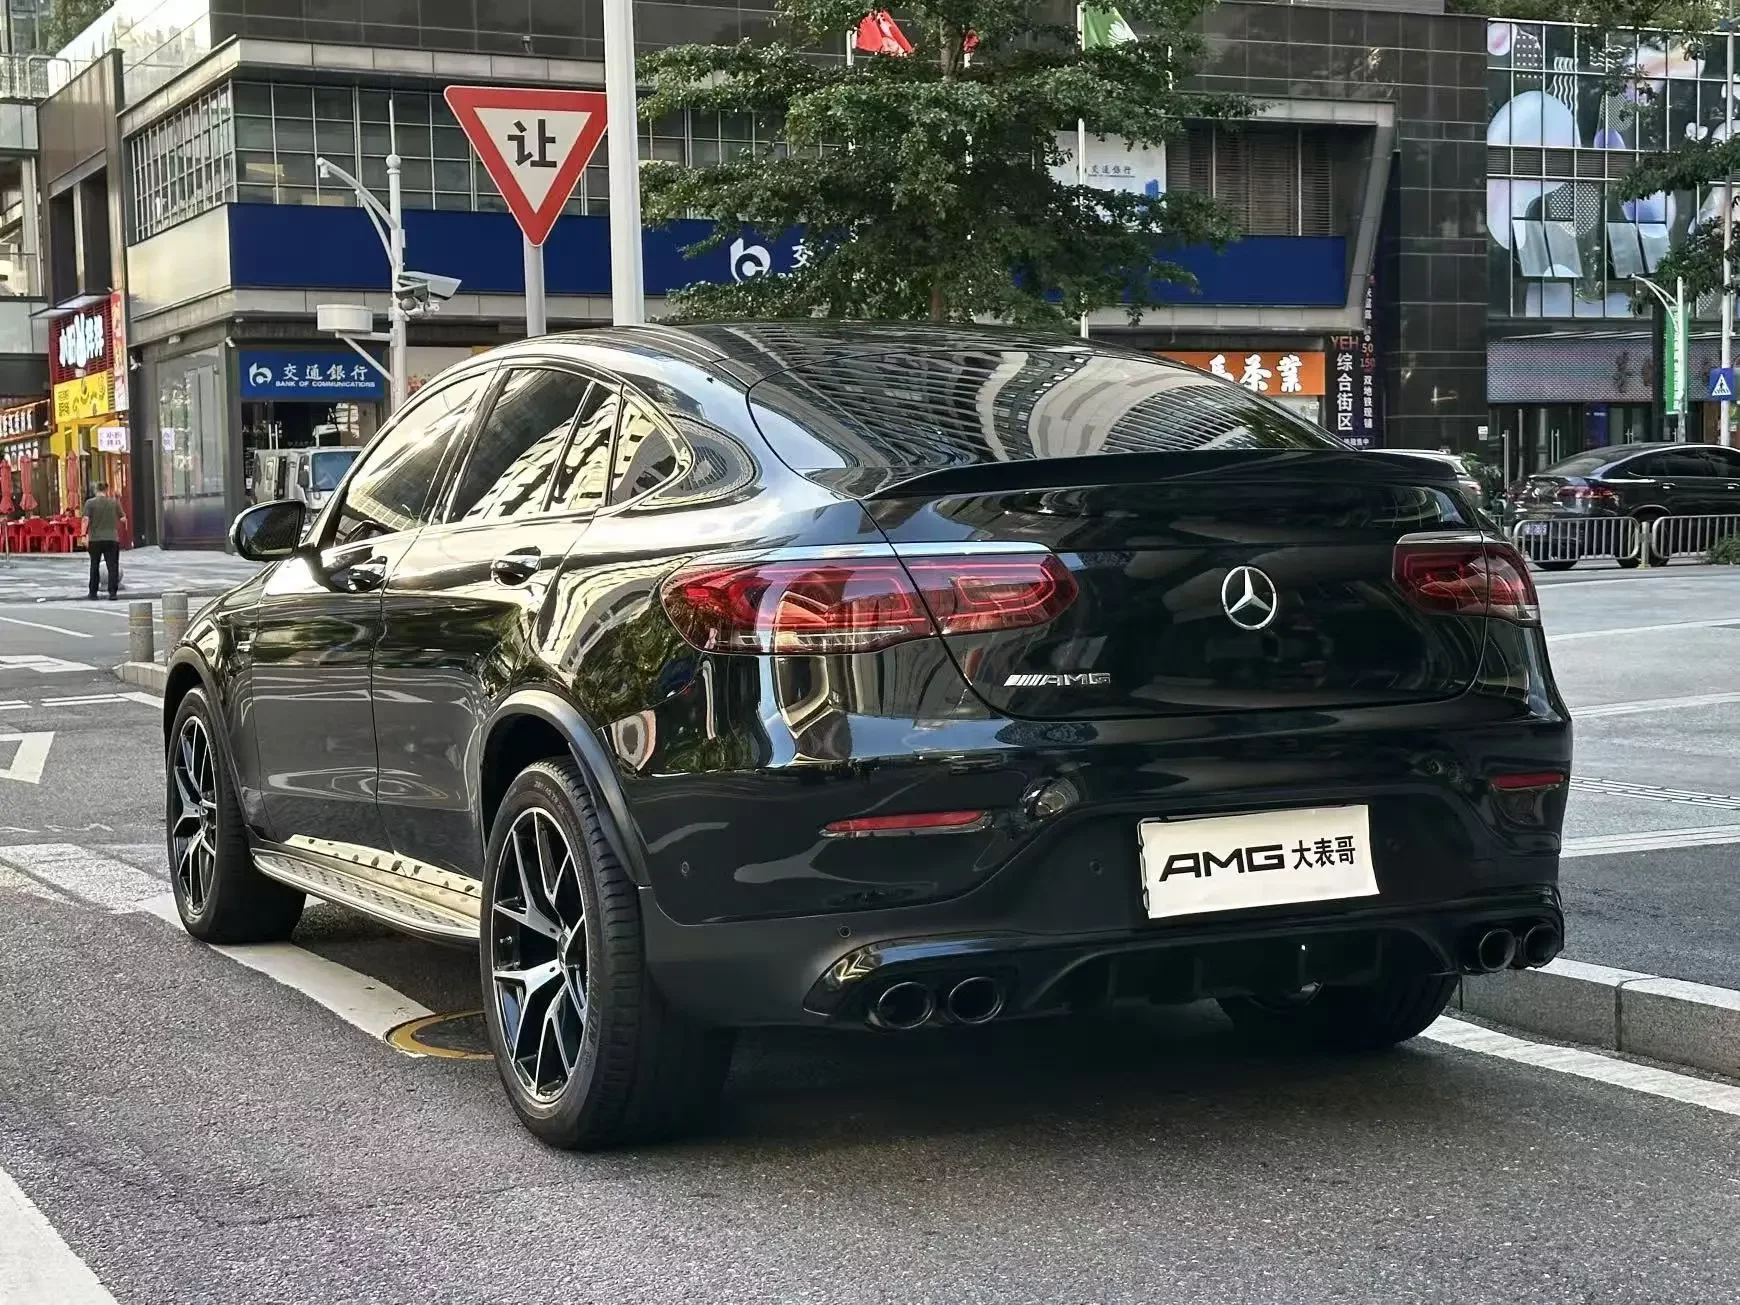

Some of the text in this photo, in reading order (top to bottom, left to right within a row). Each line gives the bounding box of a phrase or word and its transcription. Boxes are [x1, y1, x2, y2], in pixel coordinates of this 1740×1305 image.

[508, 118, 558, 168] 让
[283, 363, 368, 381] 交通銀行
[1336, 352, 1353, 430] 综合街区
[1159, 835, 1356, 882] AMG 大表哥
